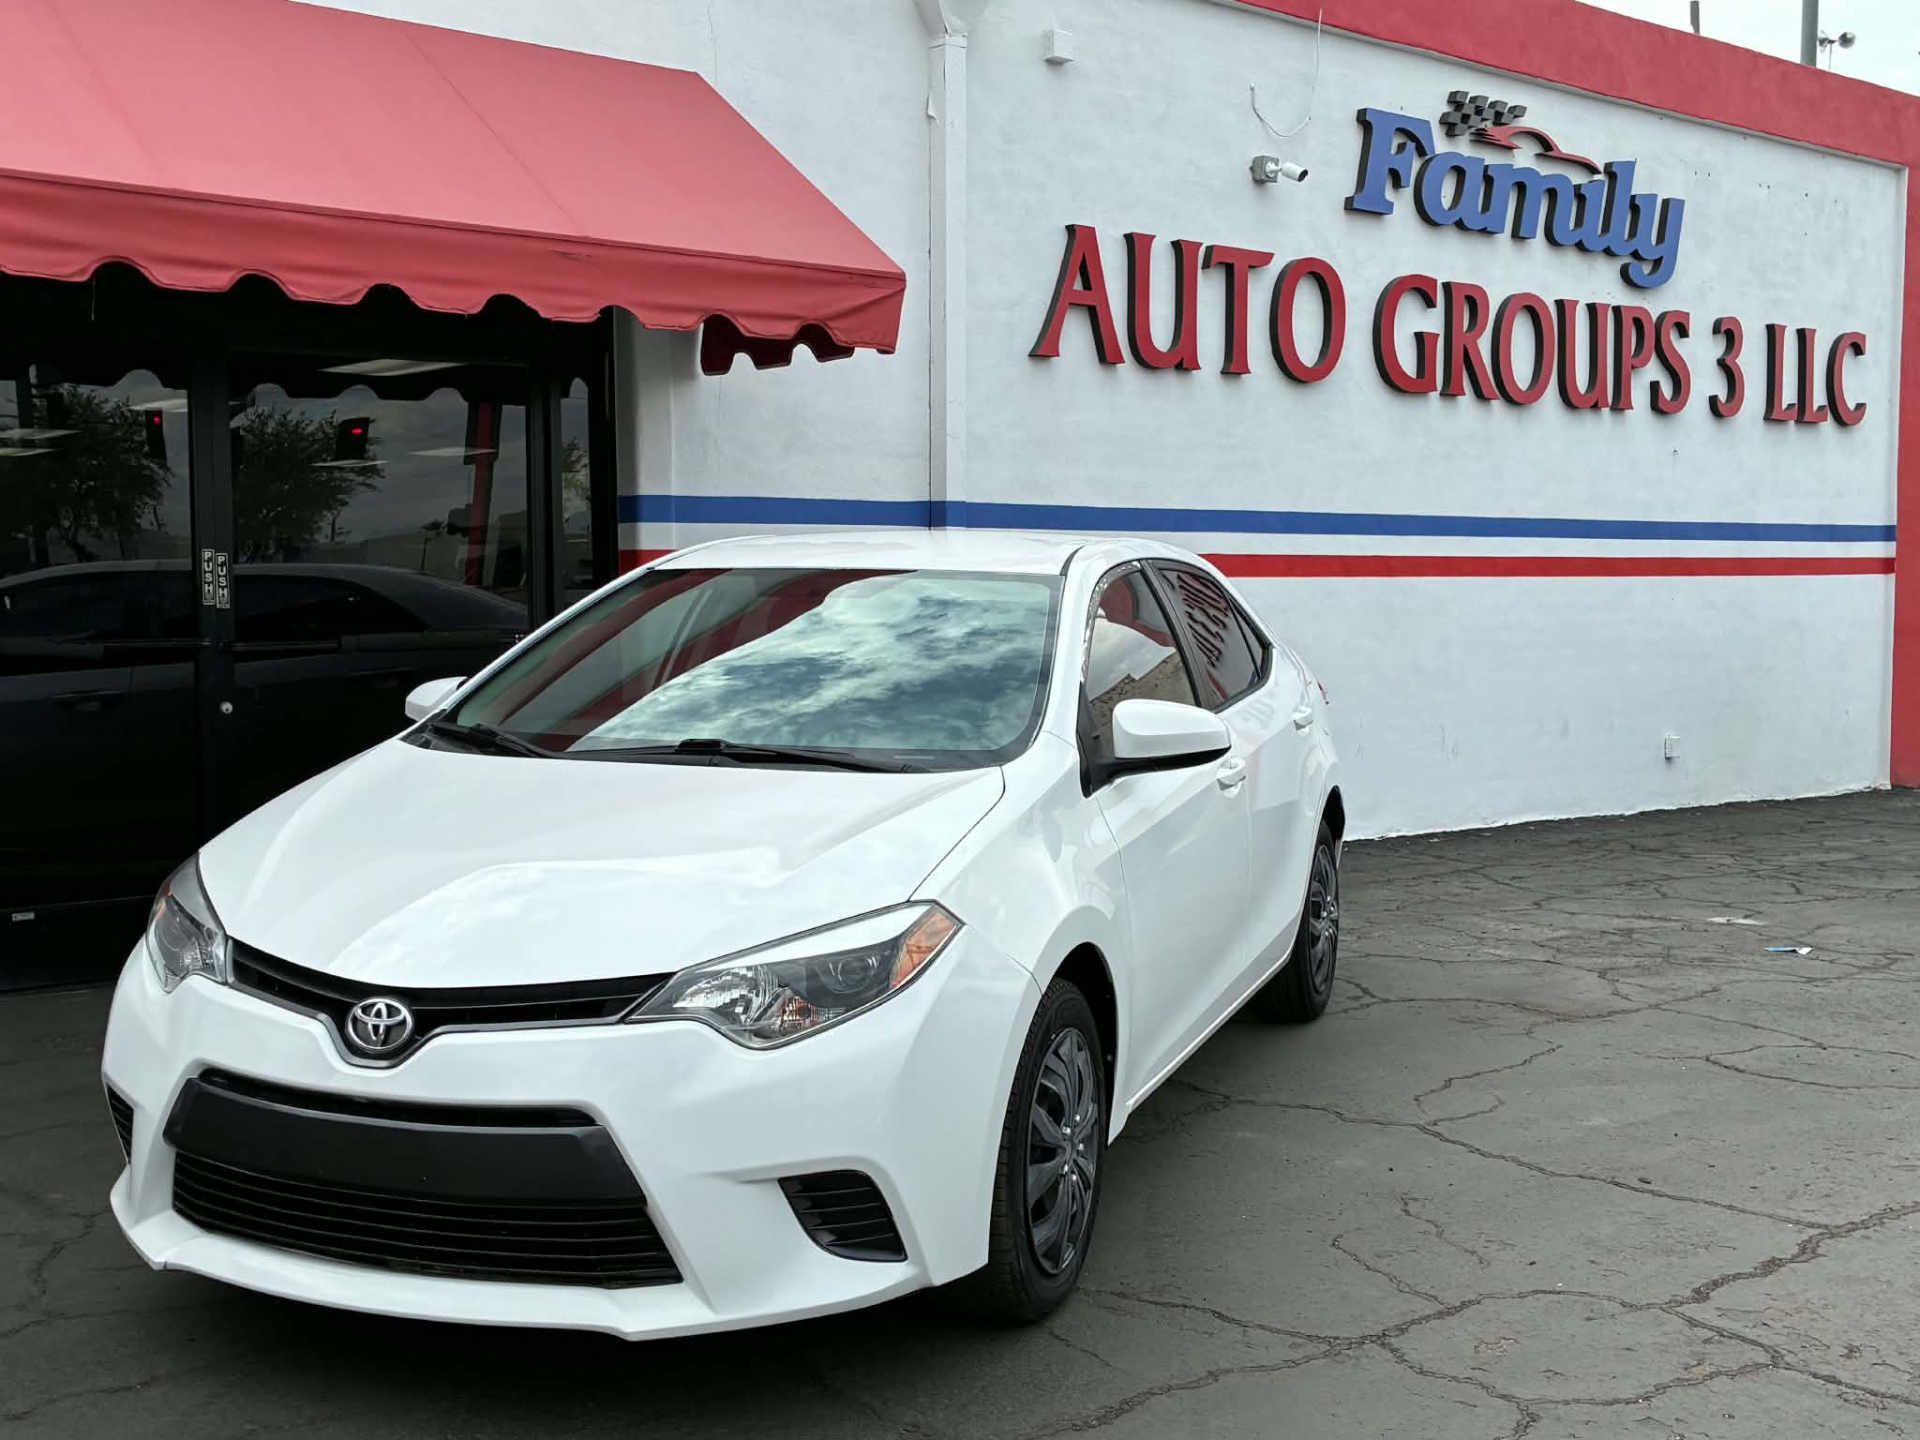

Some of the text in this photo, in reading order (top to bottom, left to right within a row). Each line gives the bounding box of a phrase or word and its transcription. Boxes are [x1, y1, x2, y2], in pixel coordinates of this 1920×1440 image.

[1344, 107, 1685, 288] Family
[1028, 223, 1867, 427] AUTO GROUPS 3 LLC
[204, 551, 213, 594] PUSH
[217, 555, 228, 598] PUSH
